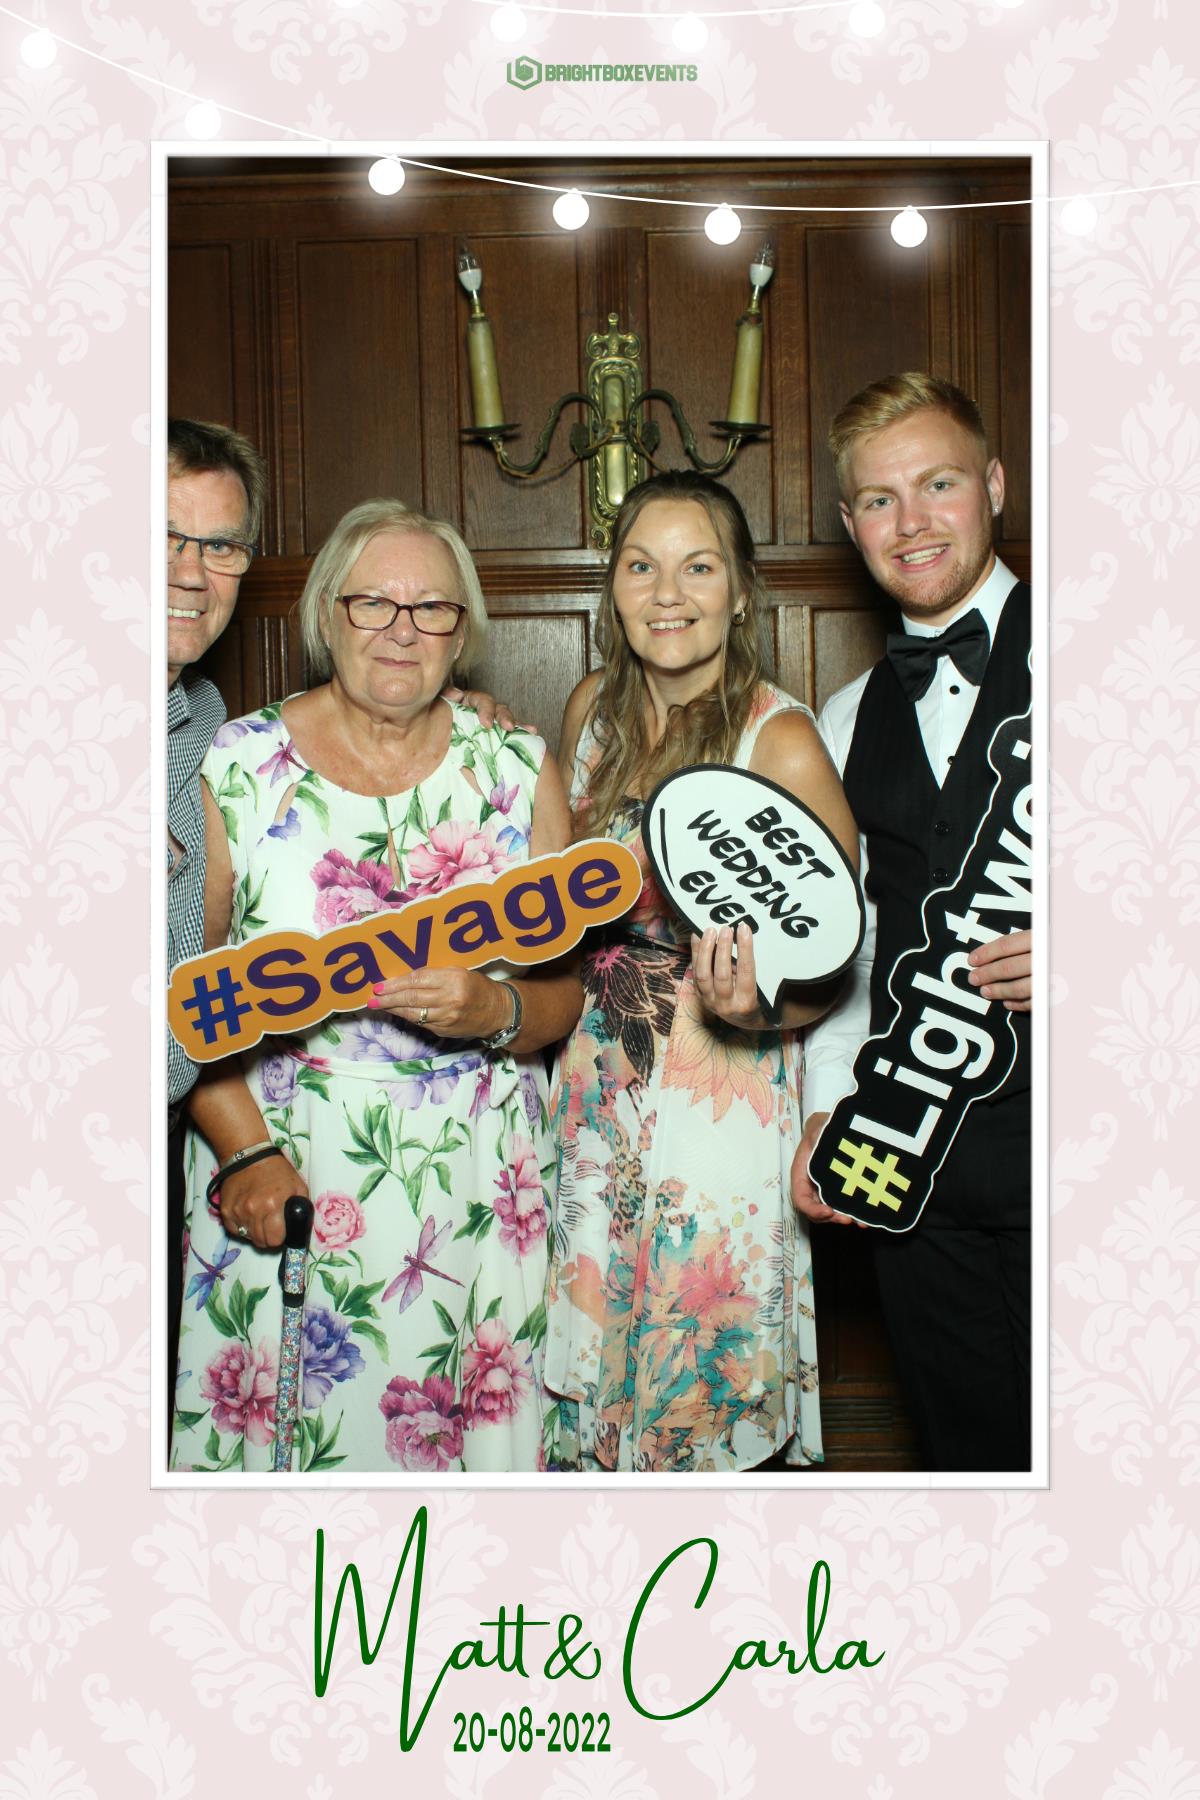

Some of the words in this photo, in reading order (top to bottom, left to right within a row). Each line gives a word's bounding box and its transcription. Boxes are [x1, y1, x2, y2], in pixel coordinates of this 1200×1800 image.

[687, 809, 819, 939] WEDDING
[744, 806, 836, 880] BEST
[181, 859, 622, 1045] #Savage
